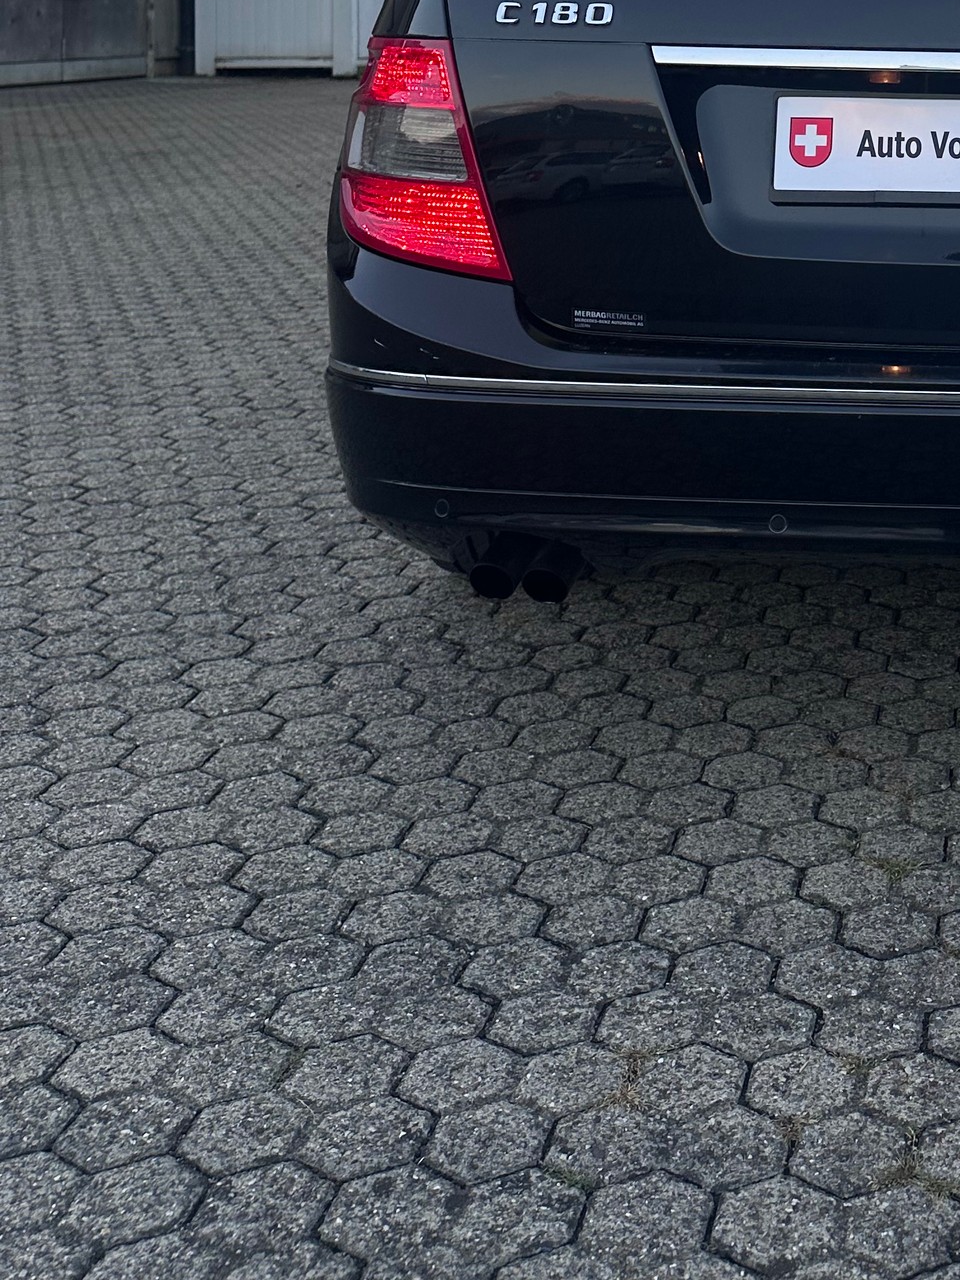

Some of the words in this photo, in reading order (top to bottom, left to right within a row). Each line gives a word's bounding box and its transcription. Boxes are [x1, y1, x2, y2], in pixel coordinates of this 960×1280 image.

[496, 1, 521, 23] C
[532, 2, 614, 25] 180
[856, 130, 922, 159] Auto
[574, 310, 644, 321] MERBAGRETAIL.CH
